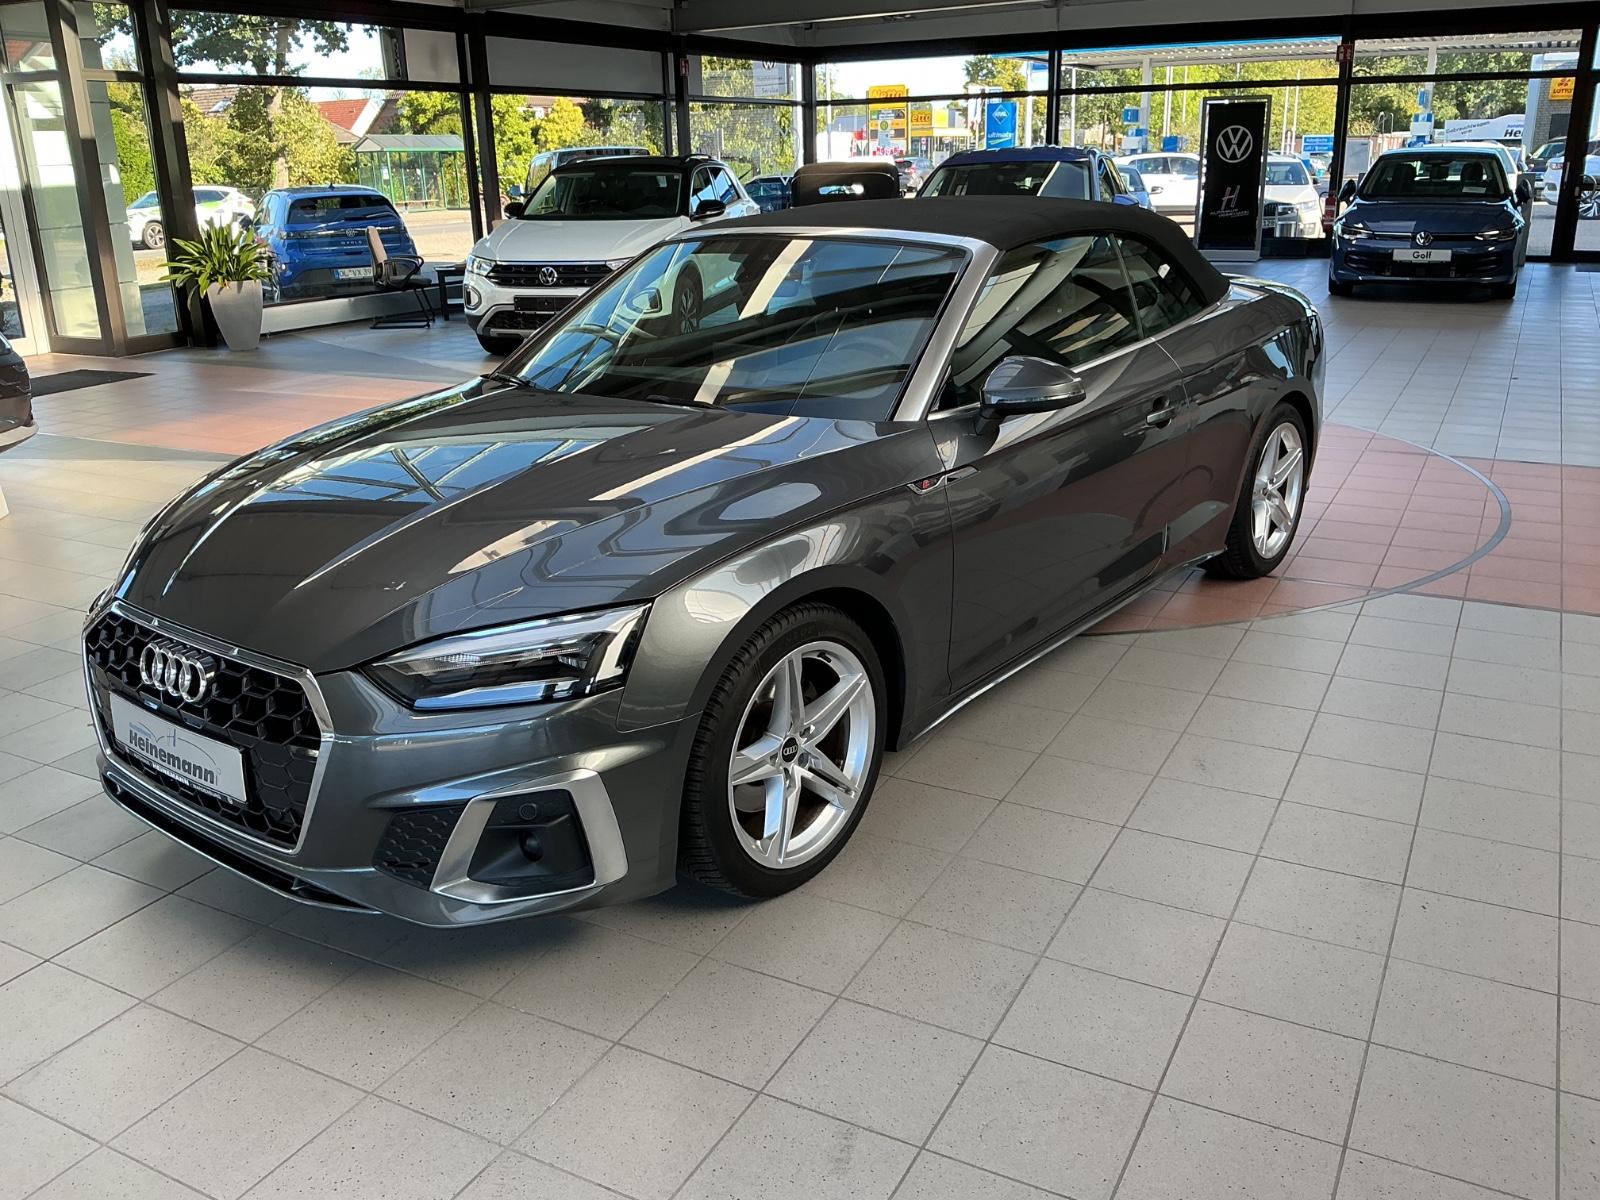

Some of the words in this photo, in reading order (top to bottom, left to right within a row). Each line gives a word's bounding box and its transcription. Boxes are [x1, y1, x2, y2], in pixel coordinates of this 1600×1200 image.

[911, 112, 931, 123] etto
[1412, 251, 1433, 259] Golf
[129, 729, 215, 785] Heinemann
[152, 762, 190, 786] HEINEMANN
